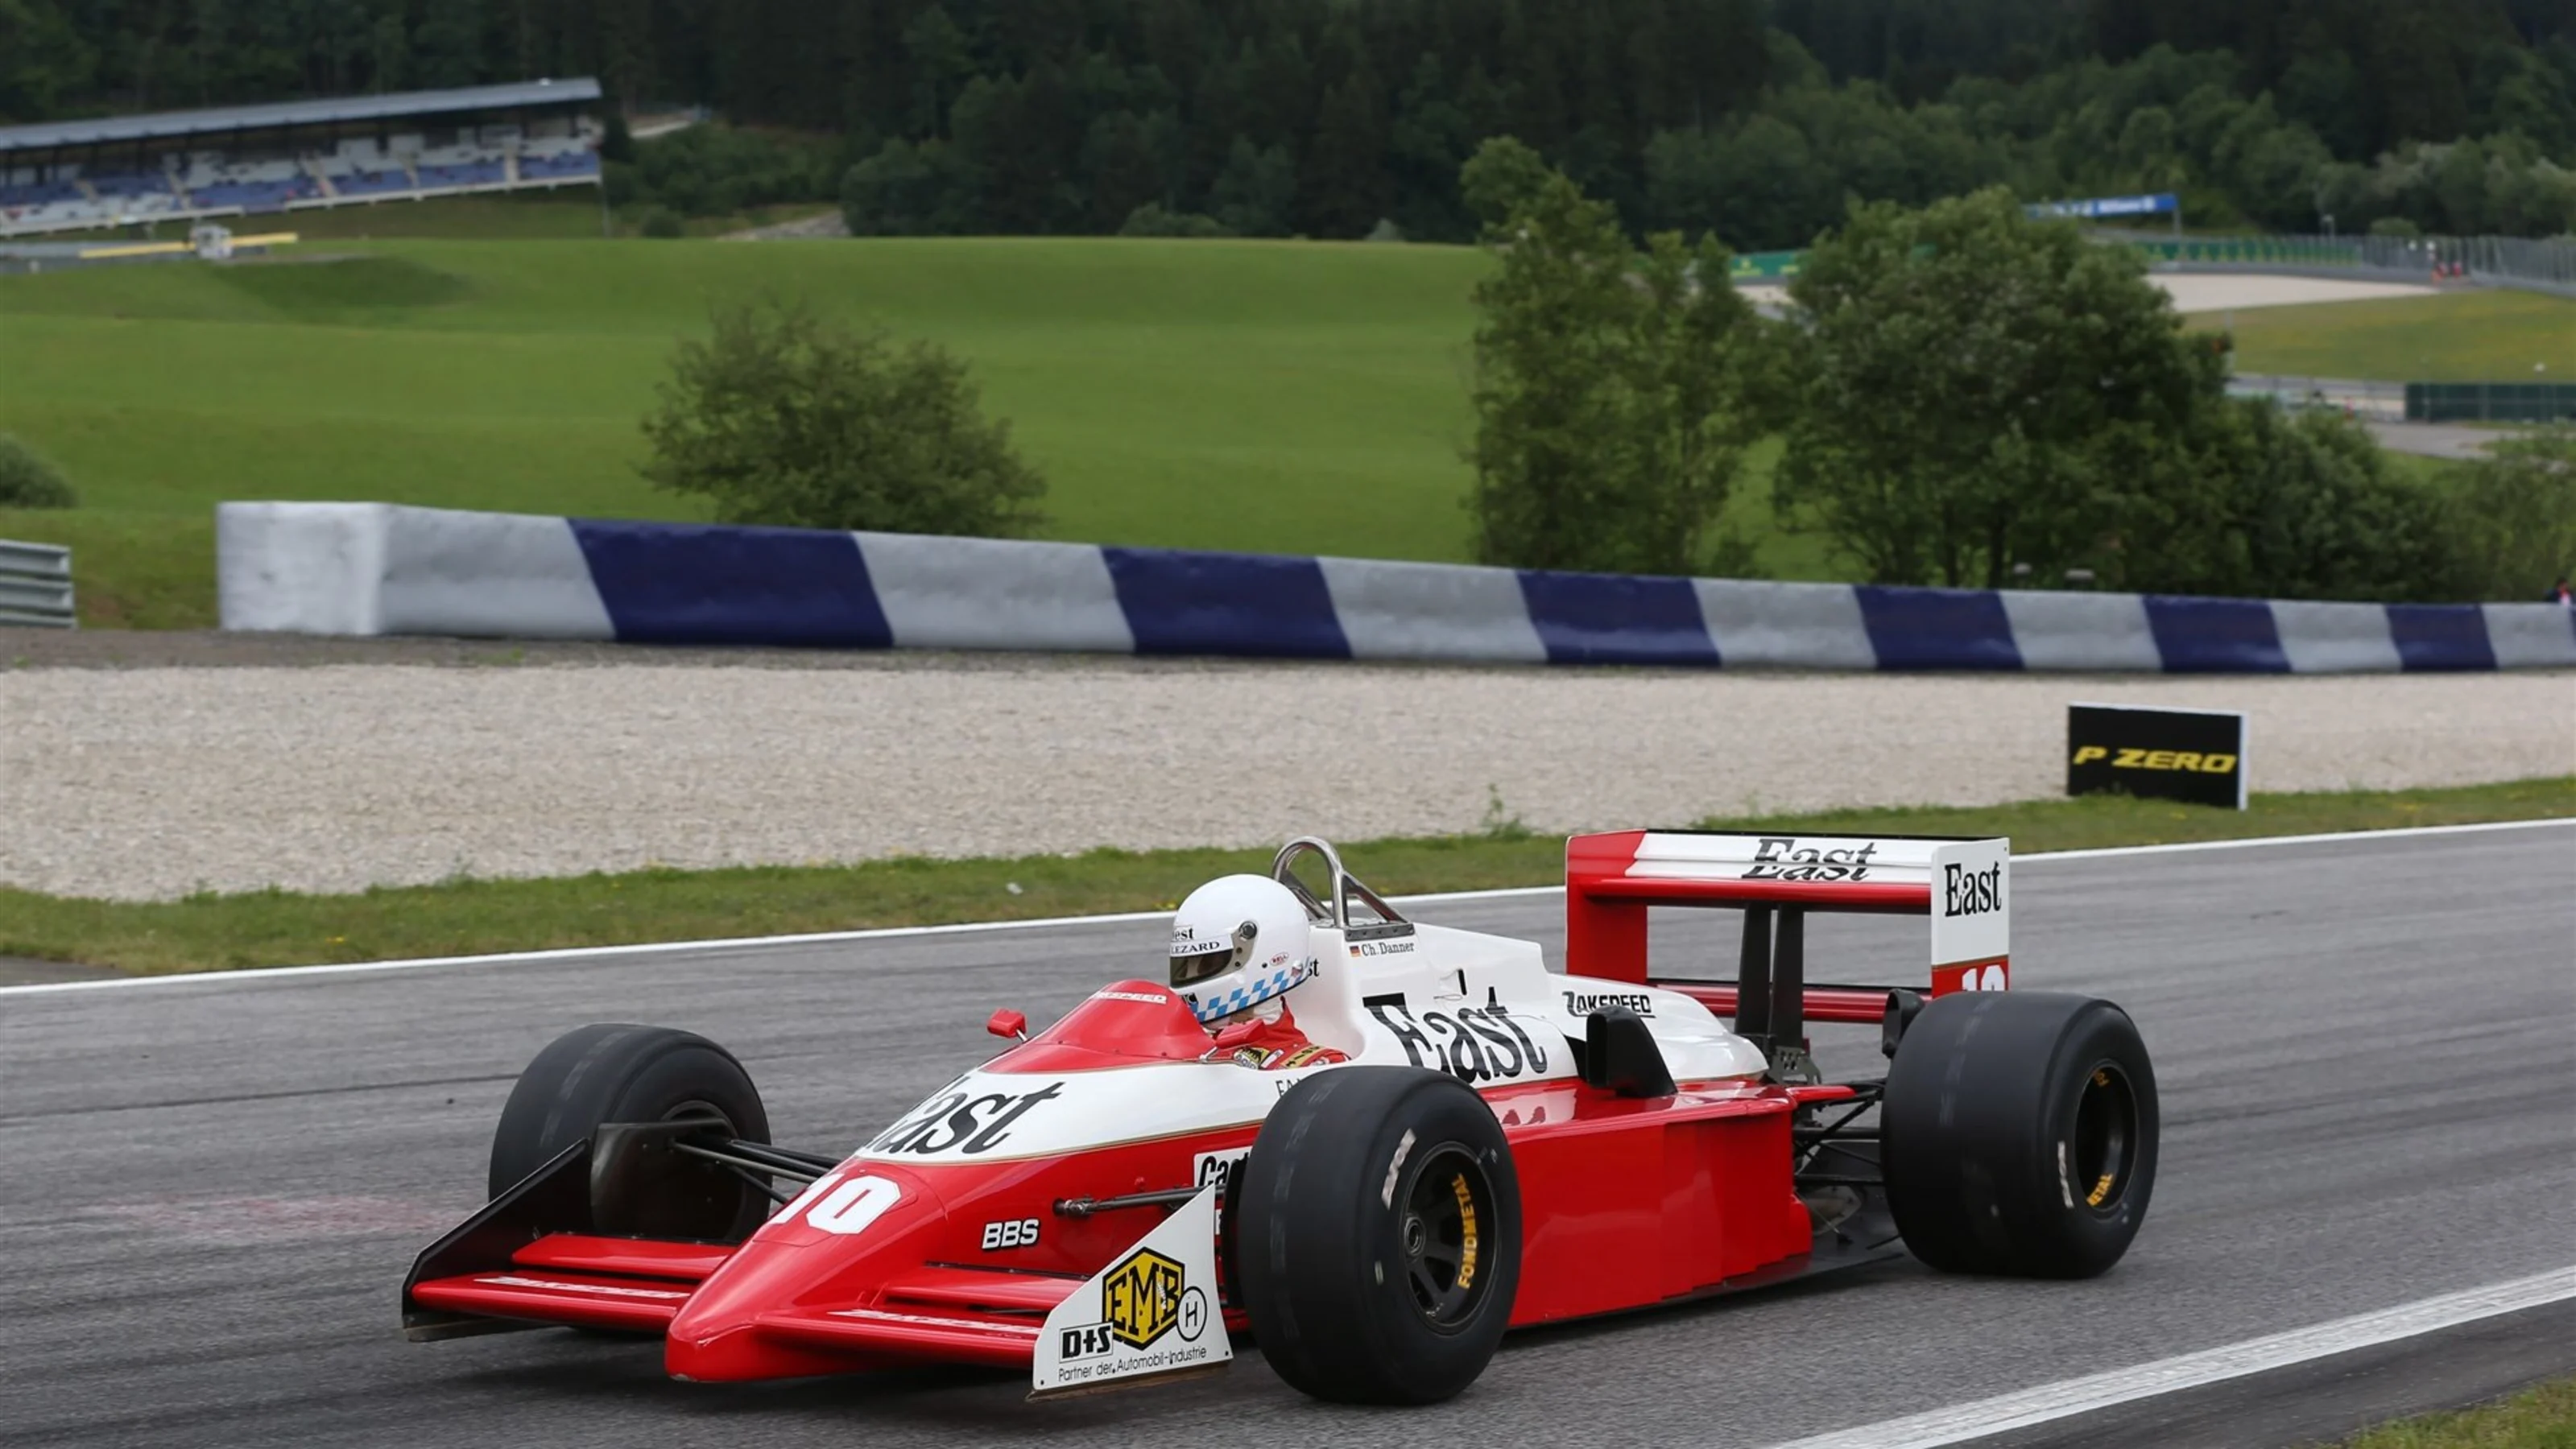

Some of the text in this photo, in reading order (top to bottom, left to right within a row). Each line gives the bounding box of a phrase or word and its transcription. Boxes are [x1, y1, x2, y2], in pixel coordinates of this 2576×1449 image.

[2074, 746, 2237, 774] P ZERO
[1741, 839, 1877, 881] East
[1944, 861, 2002, 917] East
[1362, 942, 1414, 956] Ch. Danner
[1362, 987, 1547, 1084] East
[768, 1171, 902, 1234] 10
[982, 1218, 1040, 1250] BBS
[1108, 1262, 1179, 1336] EMB
[1062, 1326, 1111, 1360] D+S
[1059, 1365, 1093, 1382] Partner
[1116, 1346, 1207, 1372] Automobil-Industrie
